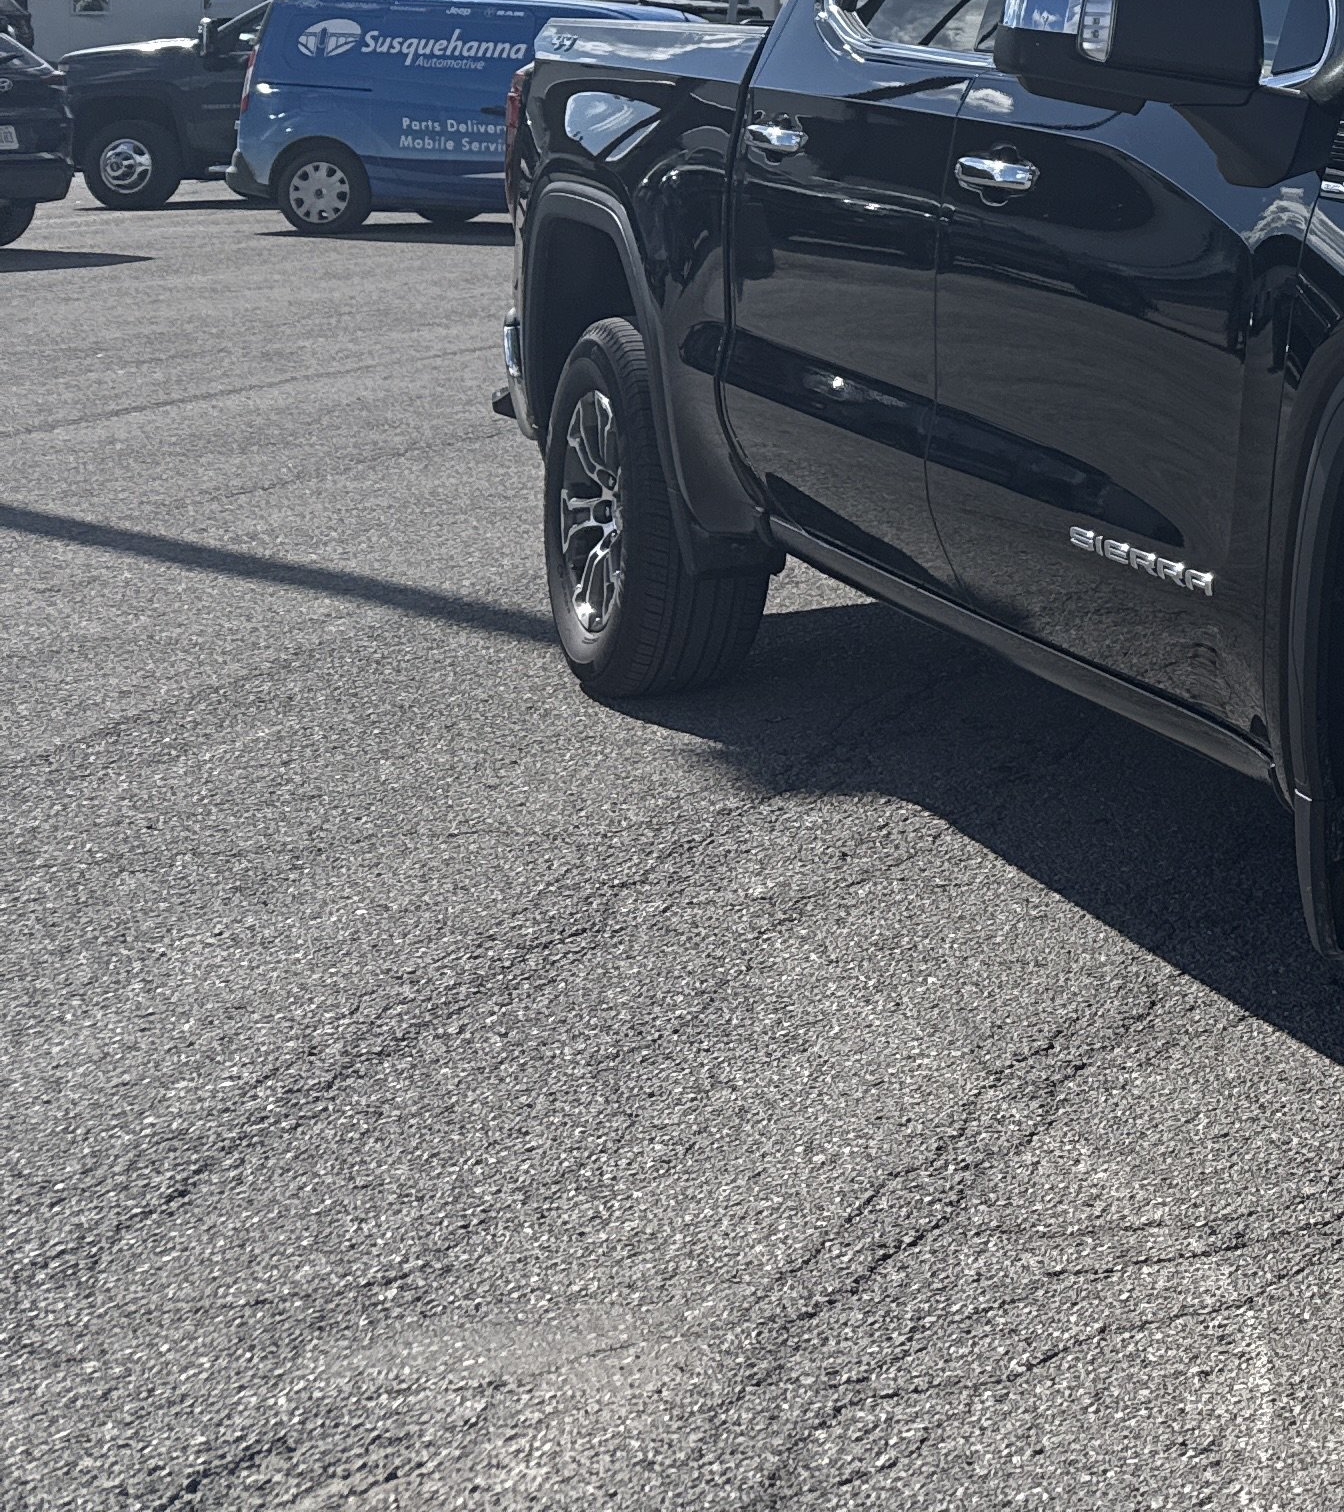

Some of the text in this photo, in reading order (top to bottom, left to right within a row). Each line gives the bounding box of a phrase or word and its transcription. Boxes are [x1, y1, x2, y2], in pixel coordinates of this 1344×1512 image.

[360, 28, 528, 66] Susquehanna
[414, 55, 486, 70] Automotive
[402, 117, 441, 131] Parts
[400, 135, 455, 150] Mobile
[1068, 525, 1215, 597] SIERRA
